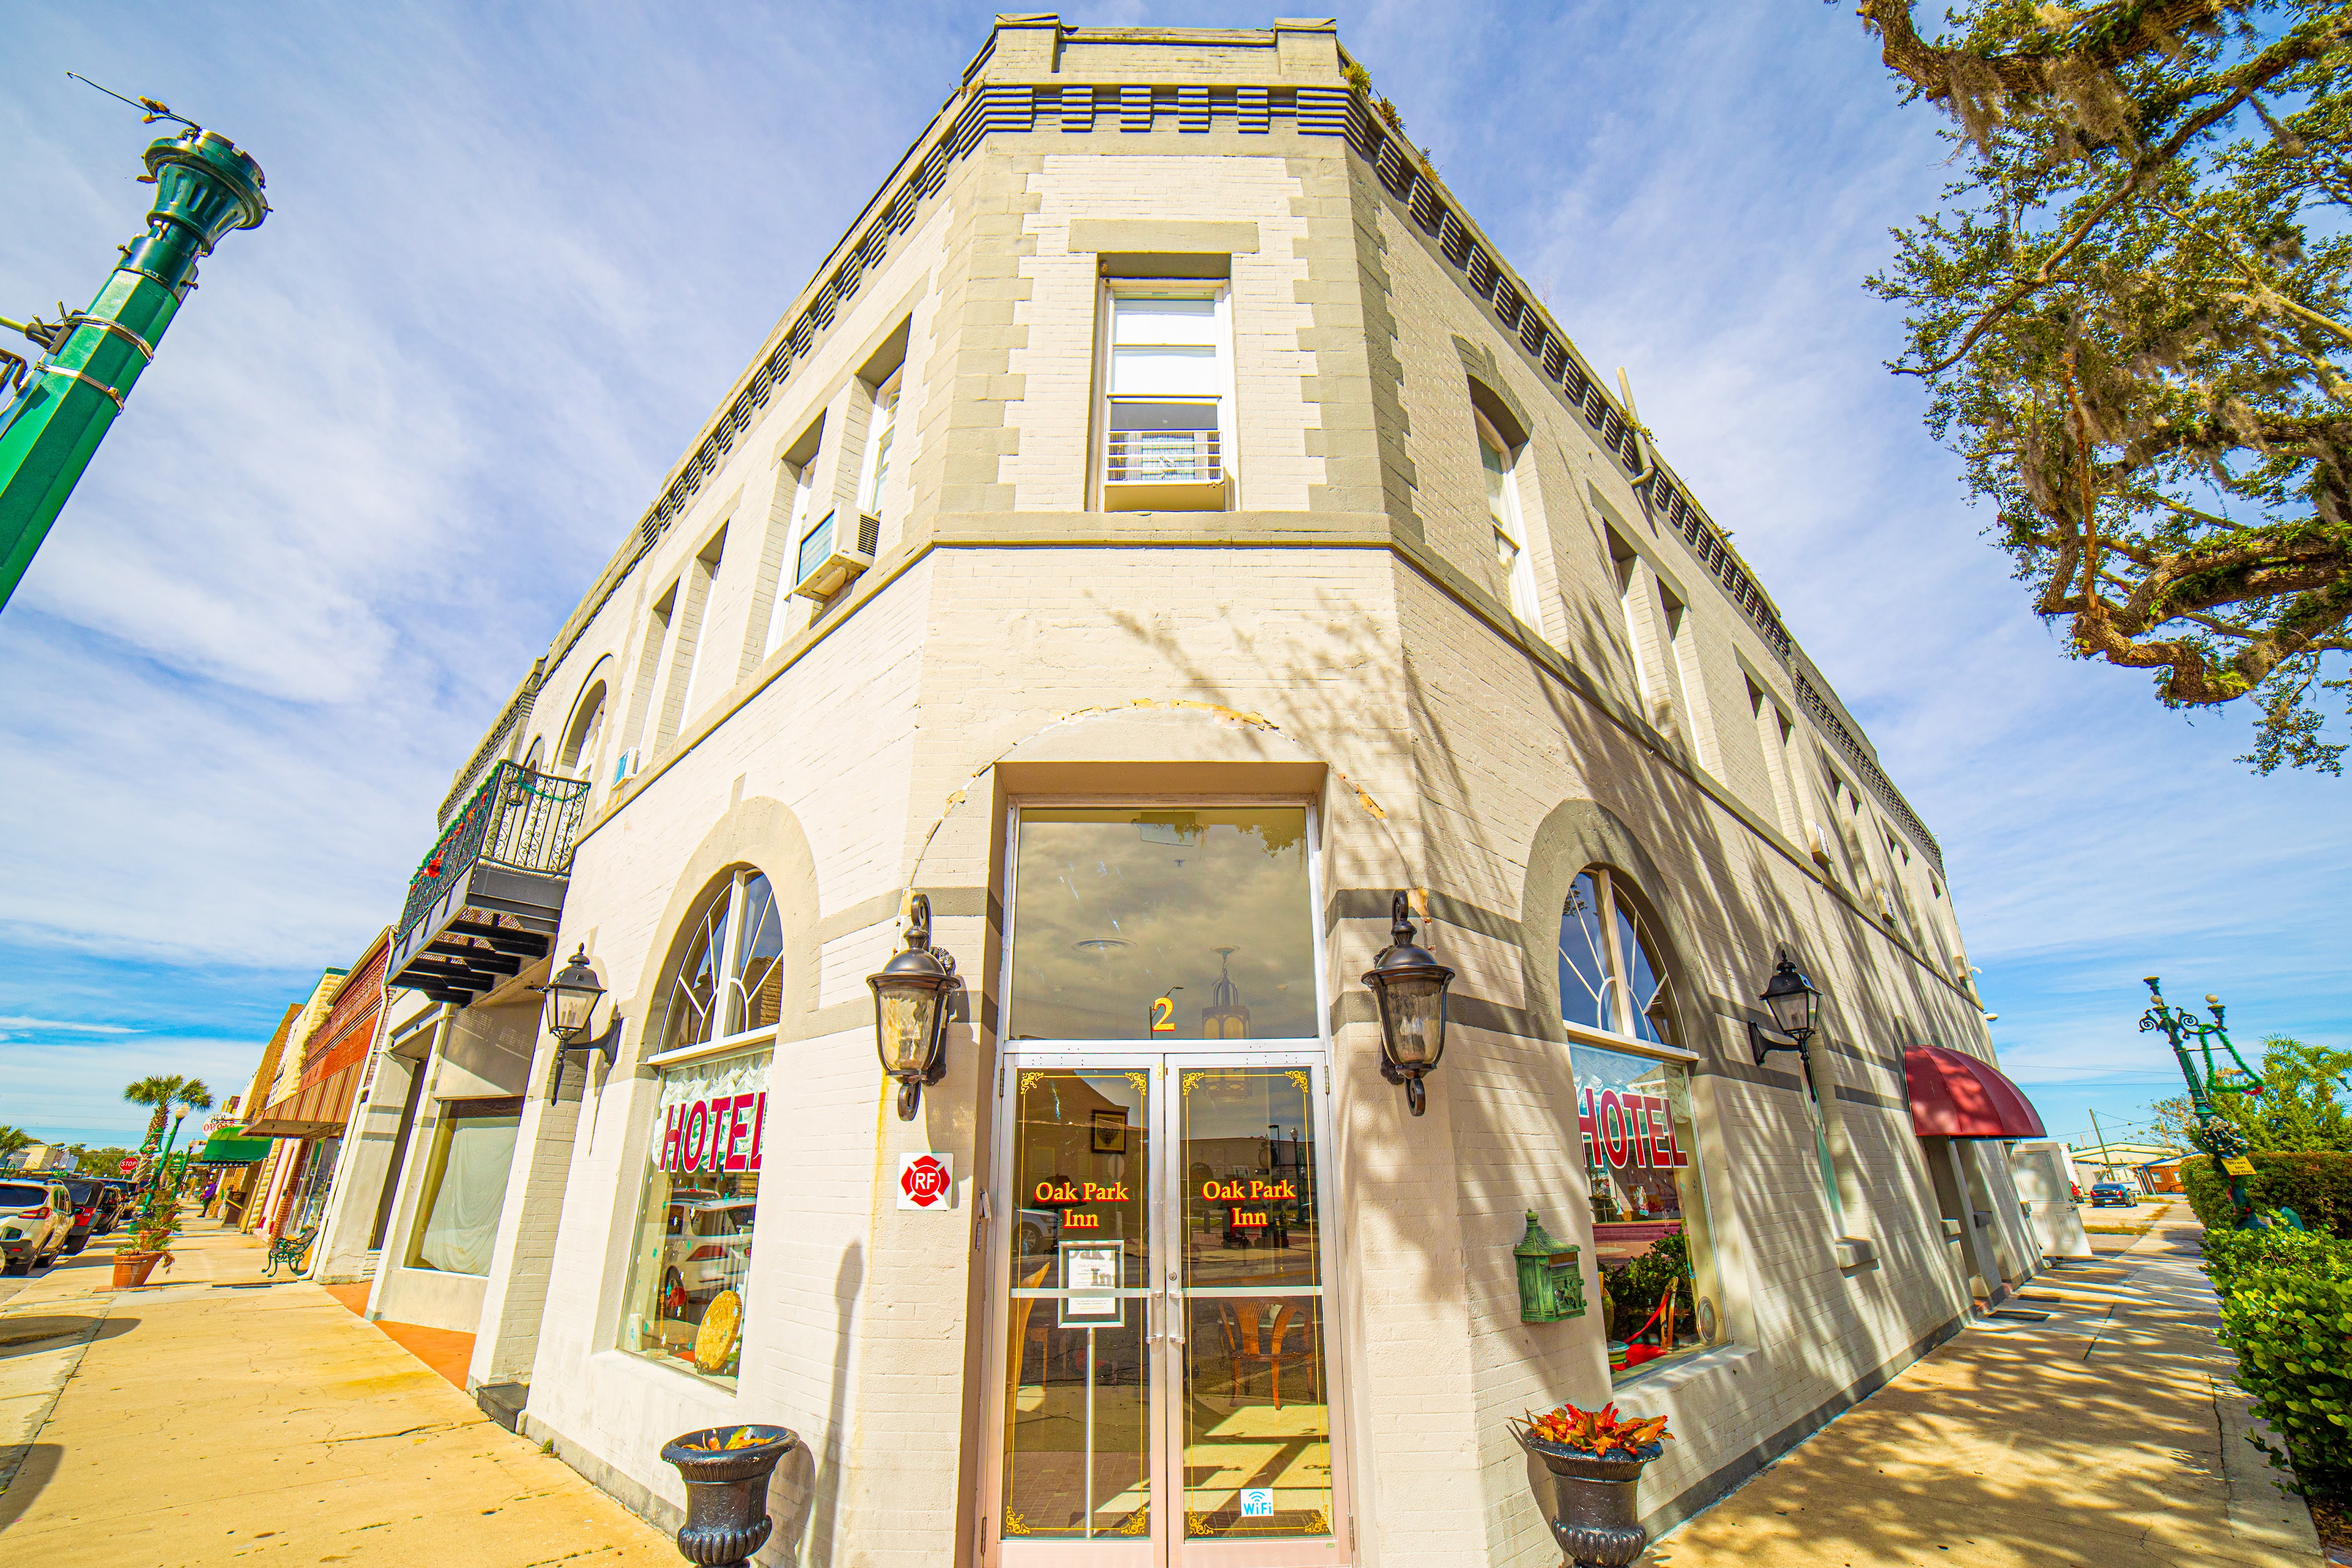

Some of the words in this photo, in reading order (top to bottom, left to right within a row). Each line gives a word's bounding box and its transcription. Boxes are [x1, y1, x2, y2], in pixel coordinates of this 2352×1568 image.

[1152, 997, 1176, 1032] 2
[658, 1088, 768, 1173] HOTEL
[1574, 1084, 1689, 1169] HOTEL
[915, 1172, 936, 1190] RF
[1202, 1180, 1246, 1201] Oak
[1249, 1179, 1297, 1200] Park
[1034, 1182, 1079, 1203] Oak
[1081, 1182, 1129, 1202] Park
[1063, 1208, 1100, 1229] Inn
[1231, 1207, 1269, 1228] Inn
[1243, 1502, 1272, 1515] WiFi
